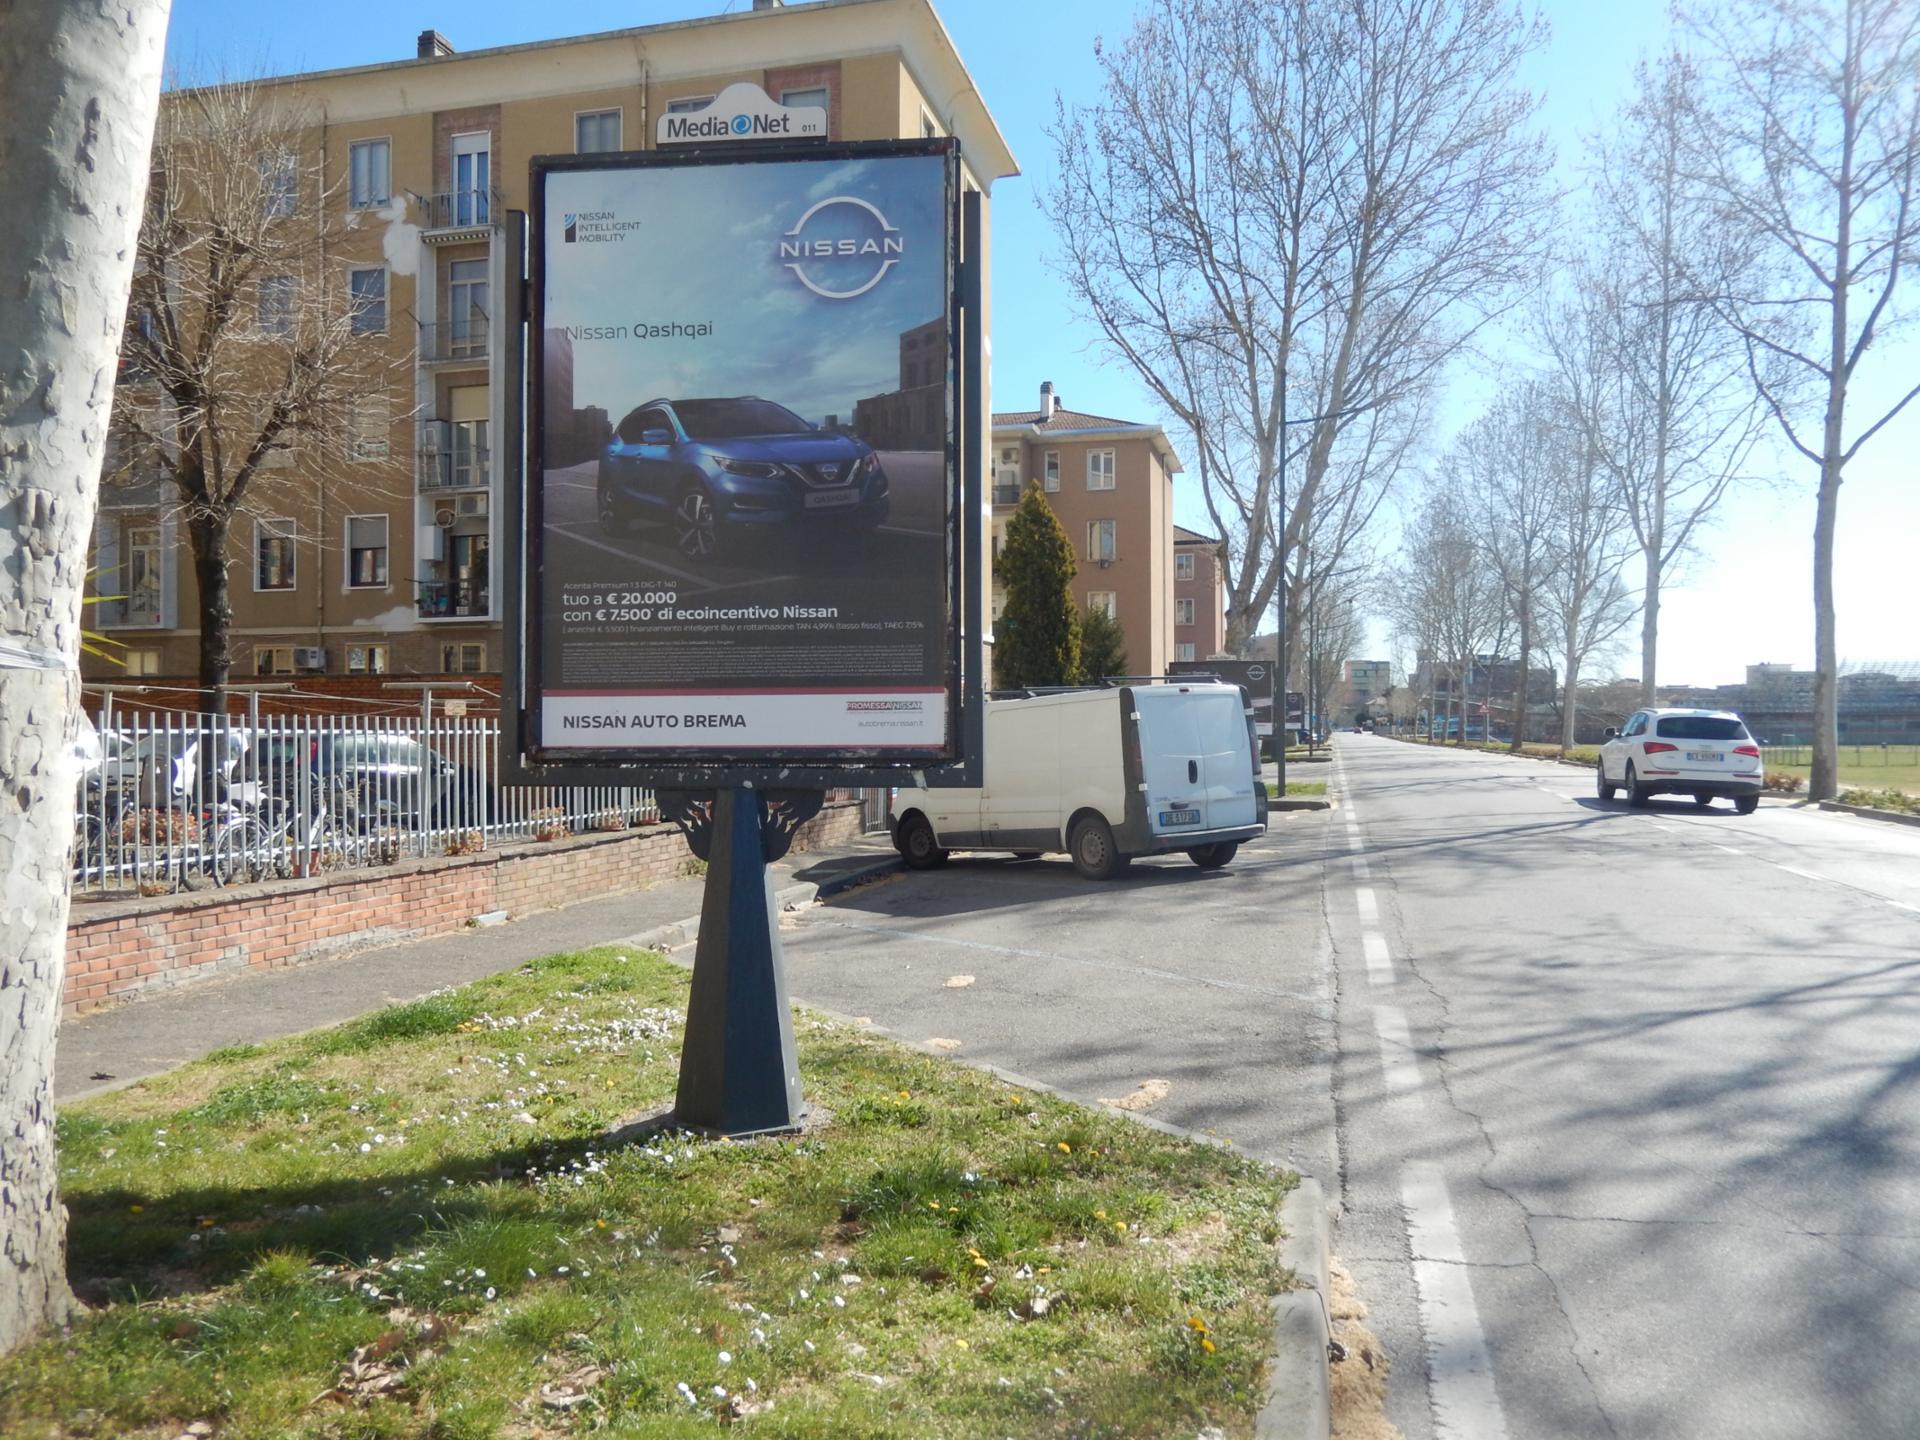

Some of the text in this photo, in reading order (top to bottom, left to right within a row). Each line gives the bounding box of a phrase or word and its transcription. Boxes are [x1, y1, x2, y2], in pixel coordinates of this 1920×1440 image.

[667, 114, 816, 138] Media Net 011
[579, 211, 615, 221] NISSAN
[579, 221, 641, 232] INTELLIGENT
[579, 233, 625, 242] MOBILITY
[780, 237, 903, 257] NISSAN
[565, 320, 713, 341] Nissan Qashqai
[562, 593, 590, 606] tuo
[593, 595, 603, 605] a
[621, 592, 677, 605] 20.000
[563, 611, 592, 622] con
[658, 607, 673, 620] di
[676, 605, 779, 620] ecoincentivo
[783, 605, 838, 618] Nissan
[563, 714, 746, 729] NISSAN AUTO BREMA
